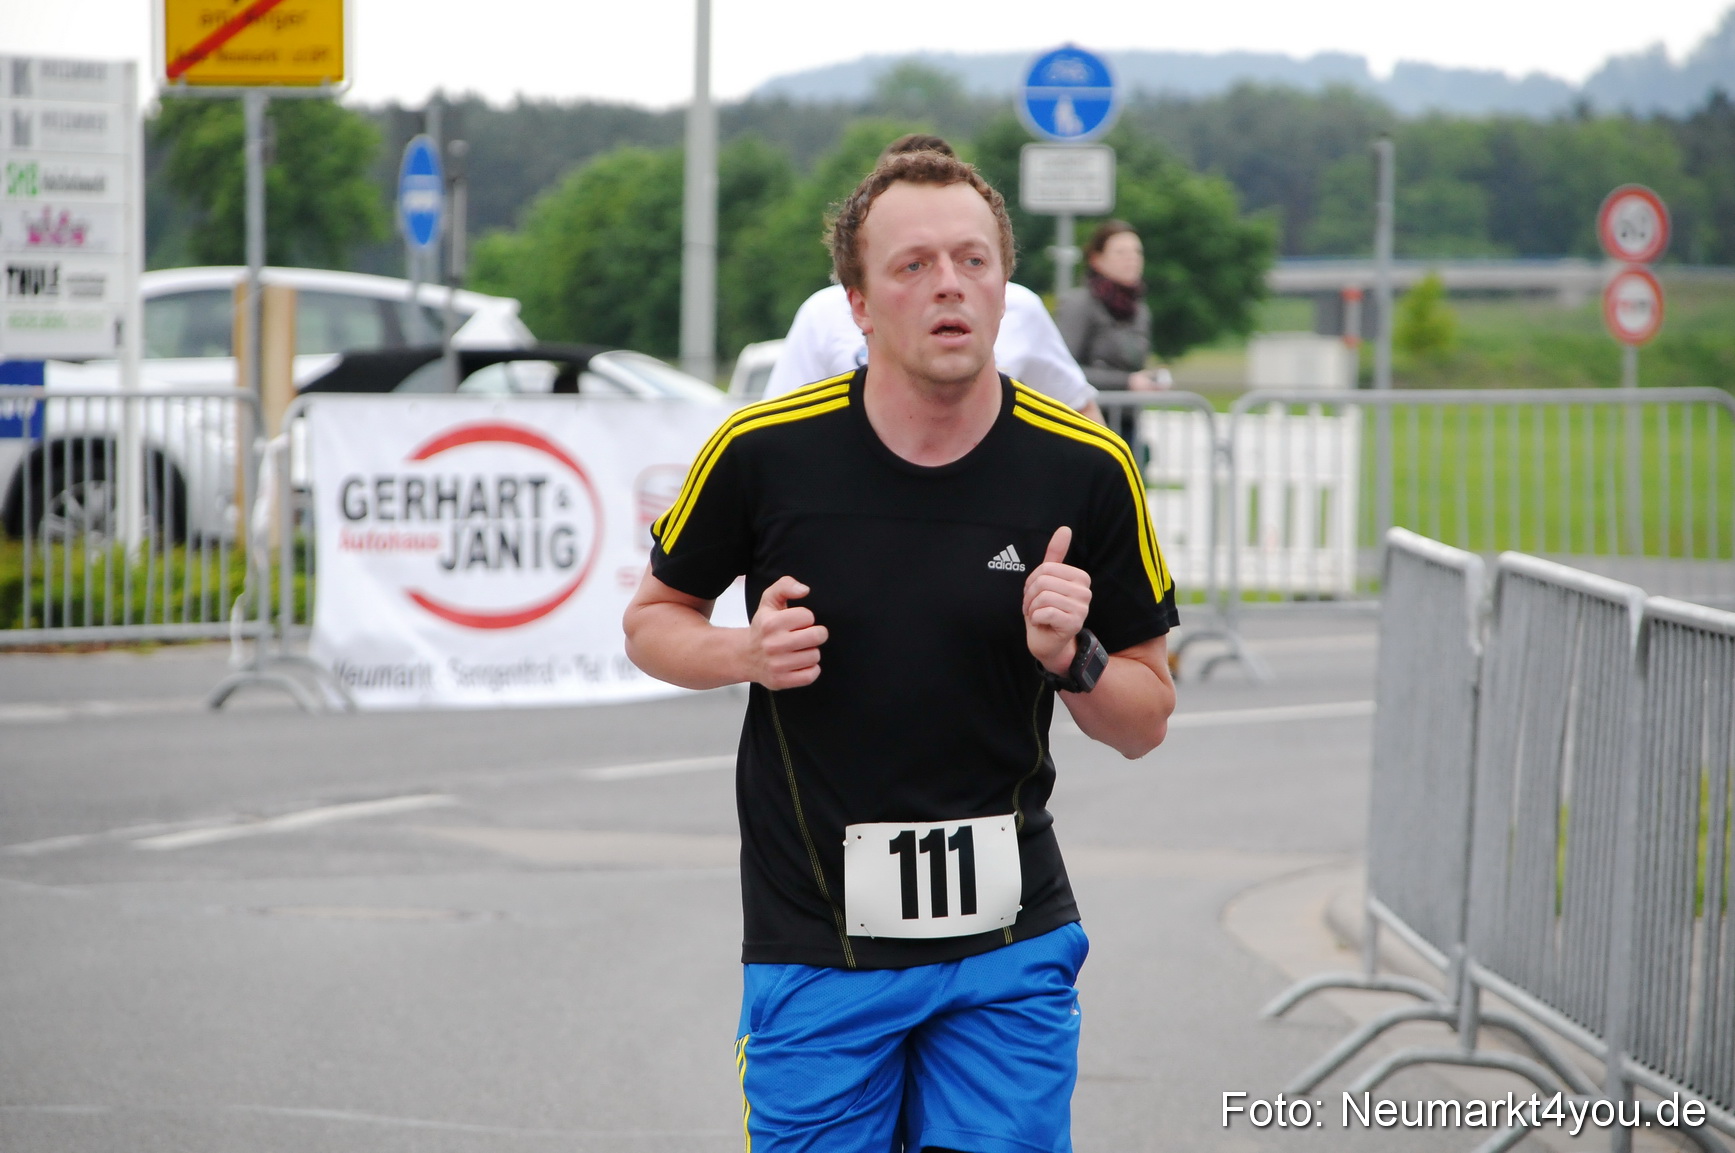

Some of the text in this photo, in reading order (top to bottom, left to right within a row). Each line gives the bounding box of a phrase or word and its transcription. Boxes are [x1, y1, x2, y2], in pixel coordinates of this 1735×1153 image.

[340, 474, 549, 521] GERHART
[338, 527, 442, 551] Autohaus
[987, 559, 1026, 572] adidas
[889, 824, 978, 921] 111
